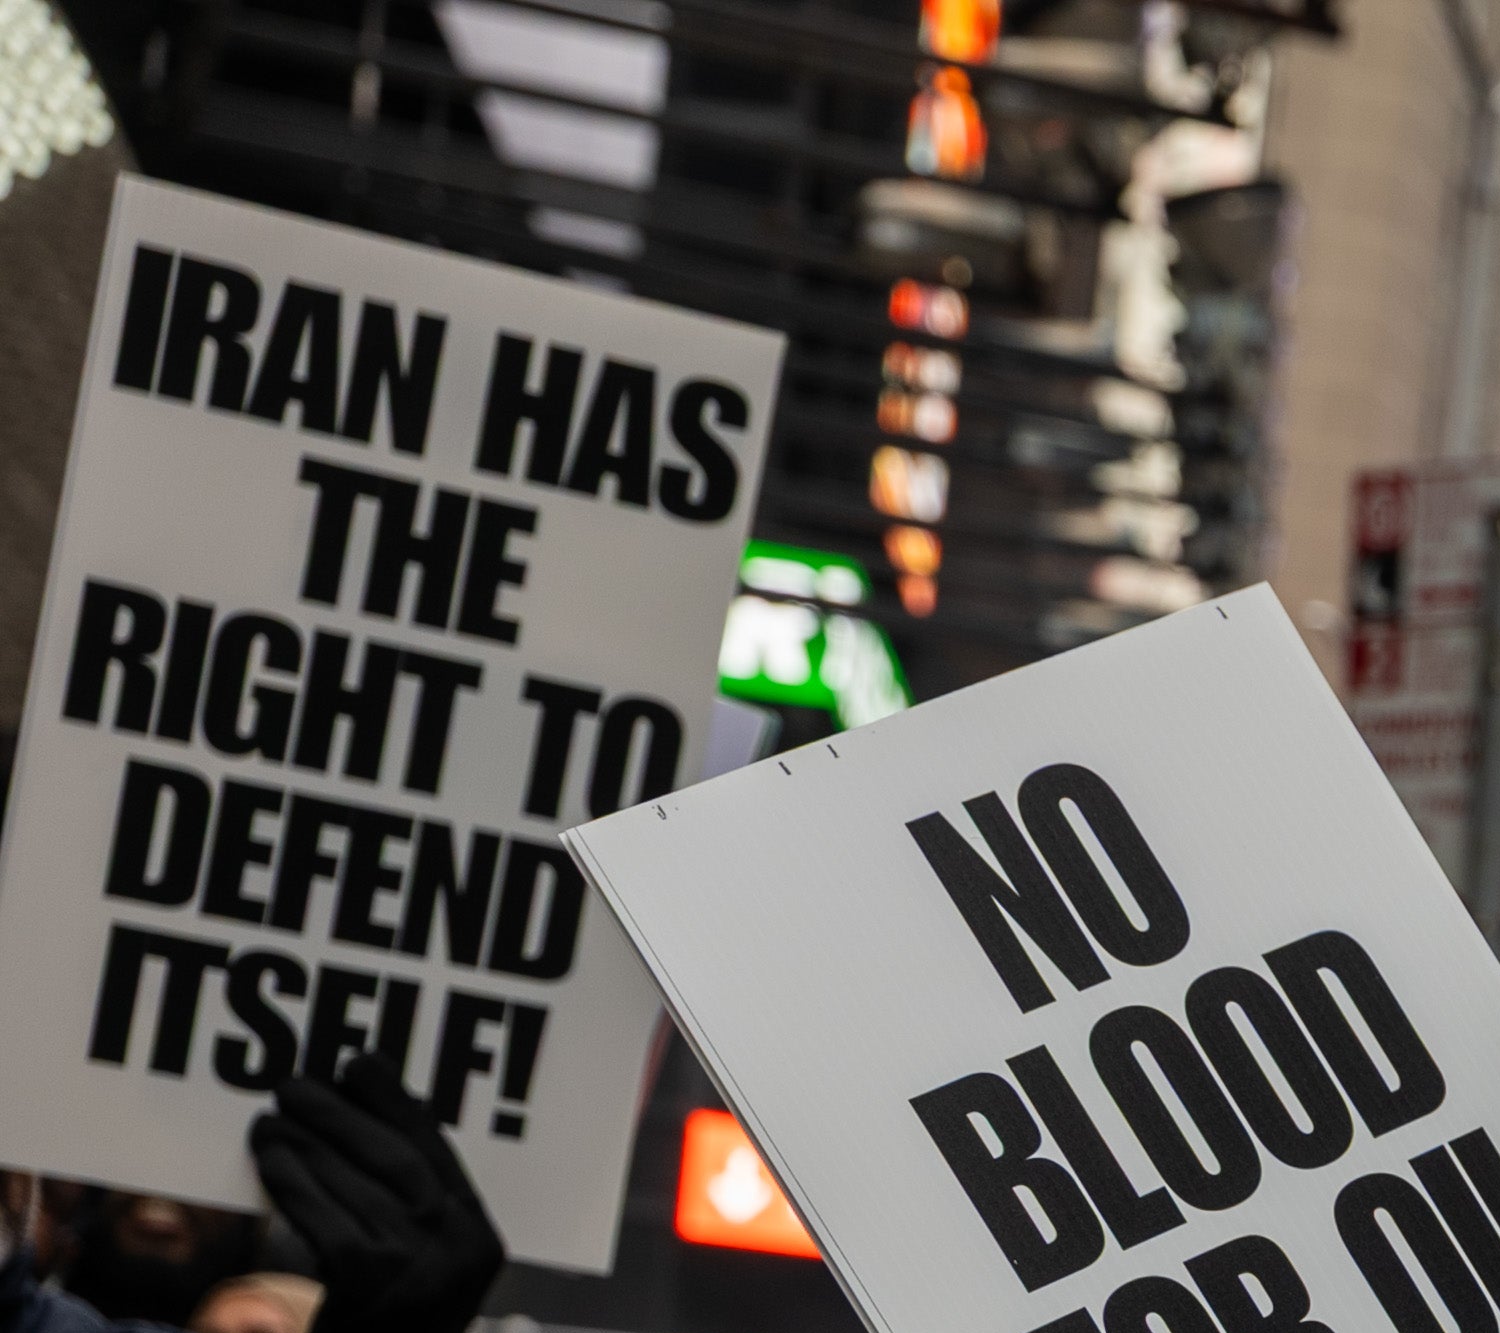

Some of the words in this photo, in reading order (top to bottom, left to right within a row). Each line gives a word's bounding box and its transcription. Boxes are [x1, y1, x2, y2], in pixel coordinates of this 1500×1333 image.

[112, 243, 448, 458] IRAN
[474, 331, 750, 526] HAS
[298, 455, 540, 648] THE
[61, 578, 485, 798] RIGHT
[521, 674, 684, 822] TO
[103, 757, 590, 984] DEFEND
[903, 762, 1192, 1015] NO
[908, 930, 1447, 1294] BLOOD
